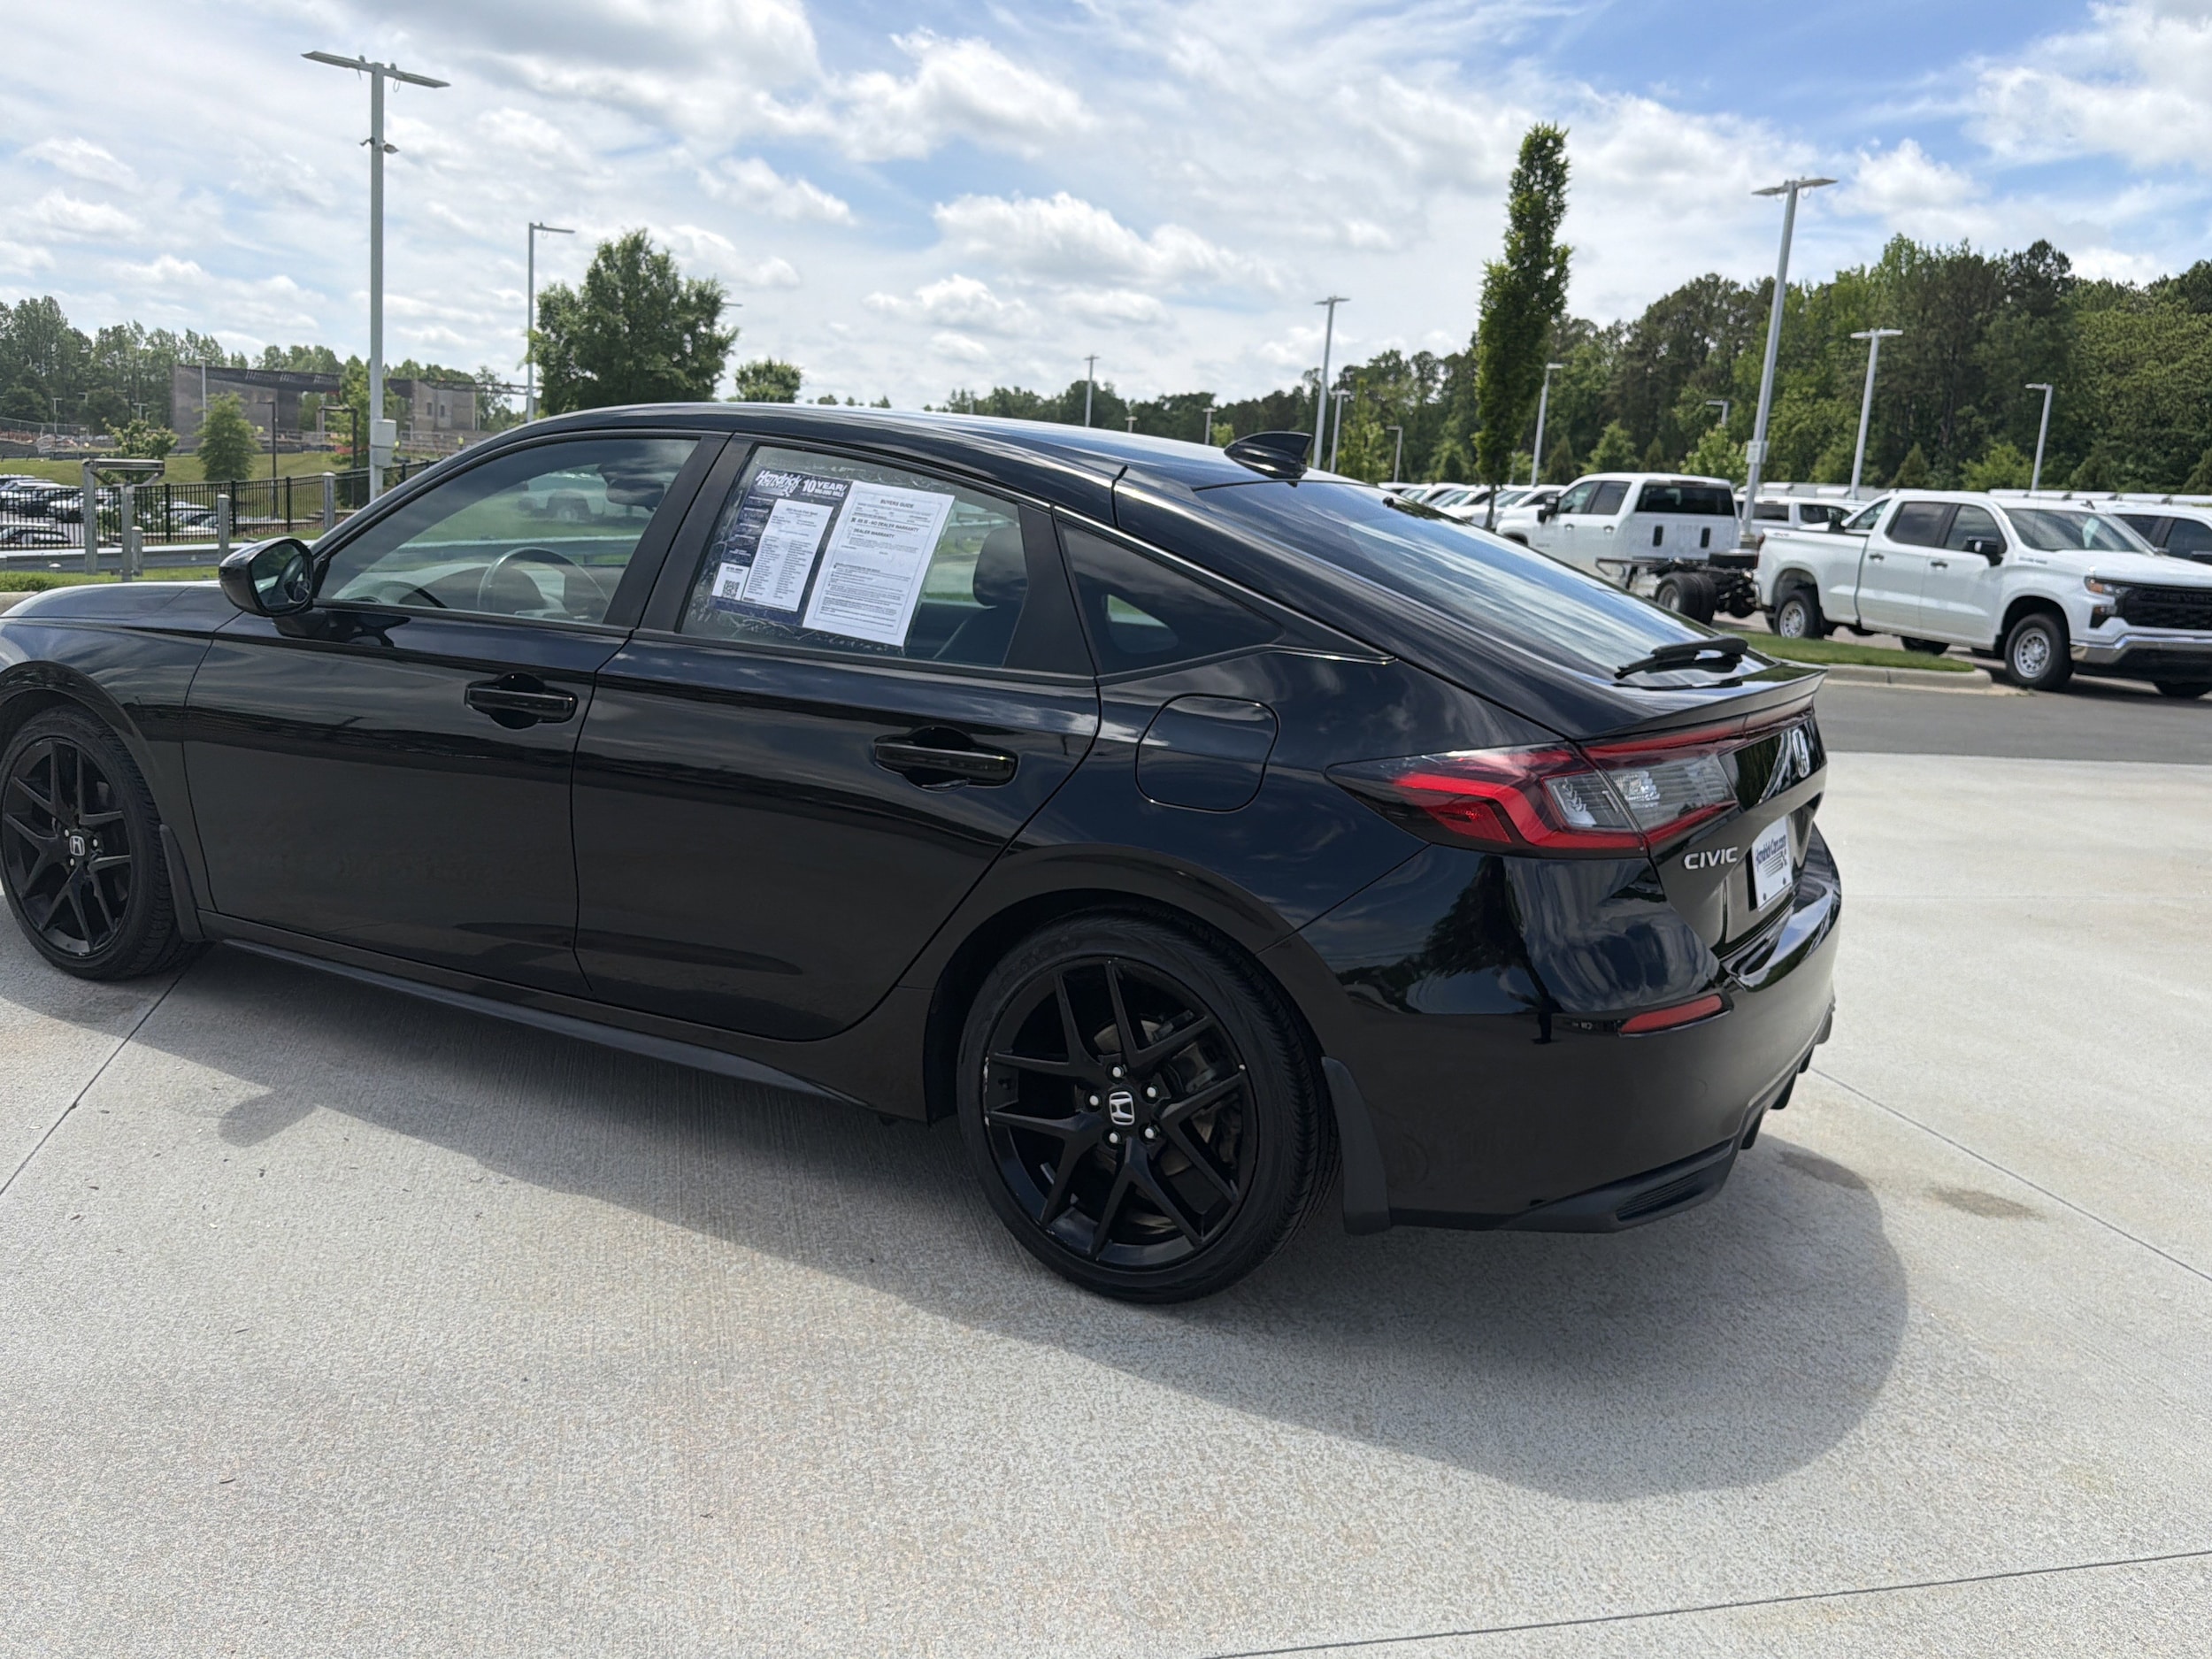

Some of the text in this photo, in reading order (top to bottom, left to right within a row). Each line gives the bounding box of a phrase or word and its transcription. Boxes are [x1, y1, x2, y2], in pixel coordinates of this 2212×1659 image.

[756, 470, 803, 493] Hendrick
[803, 479, 818, 493] 10
[1684, 847, 1739, 870] CIVIC
